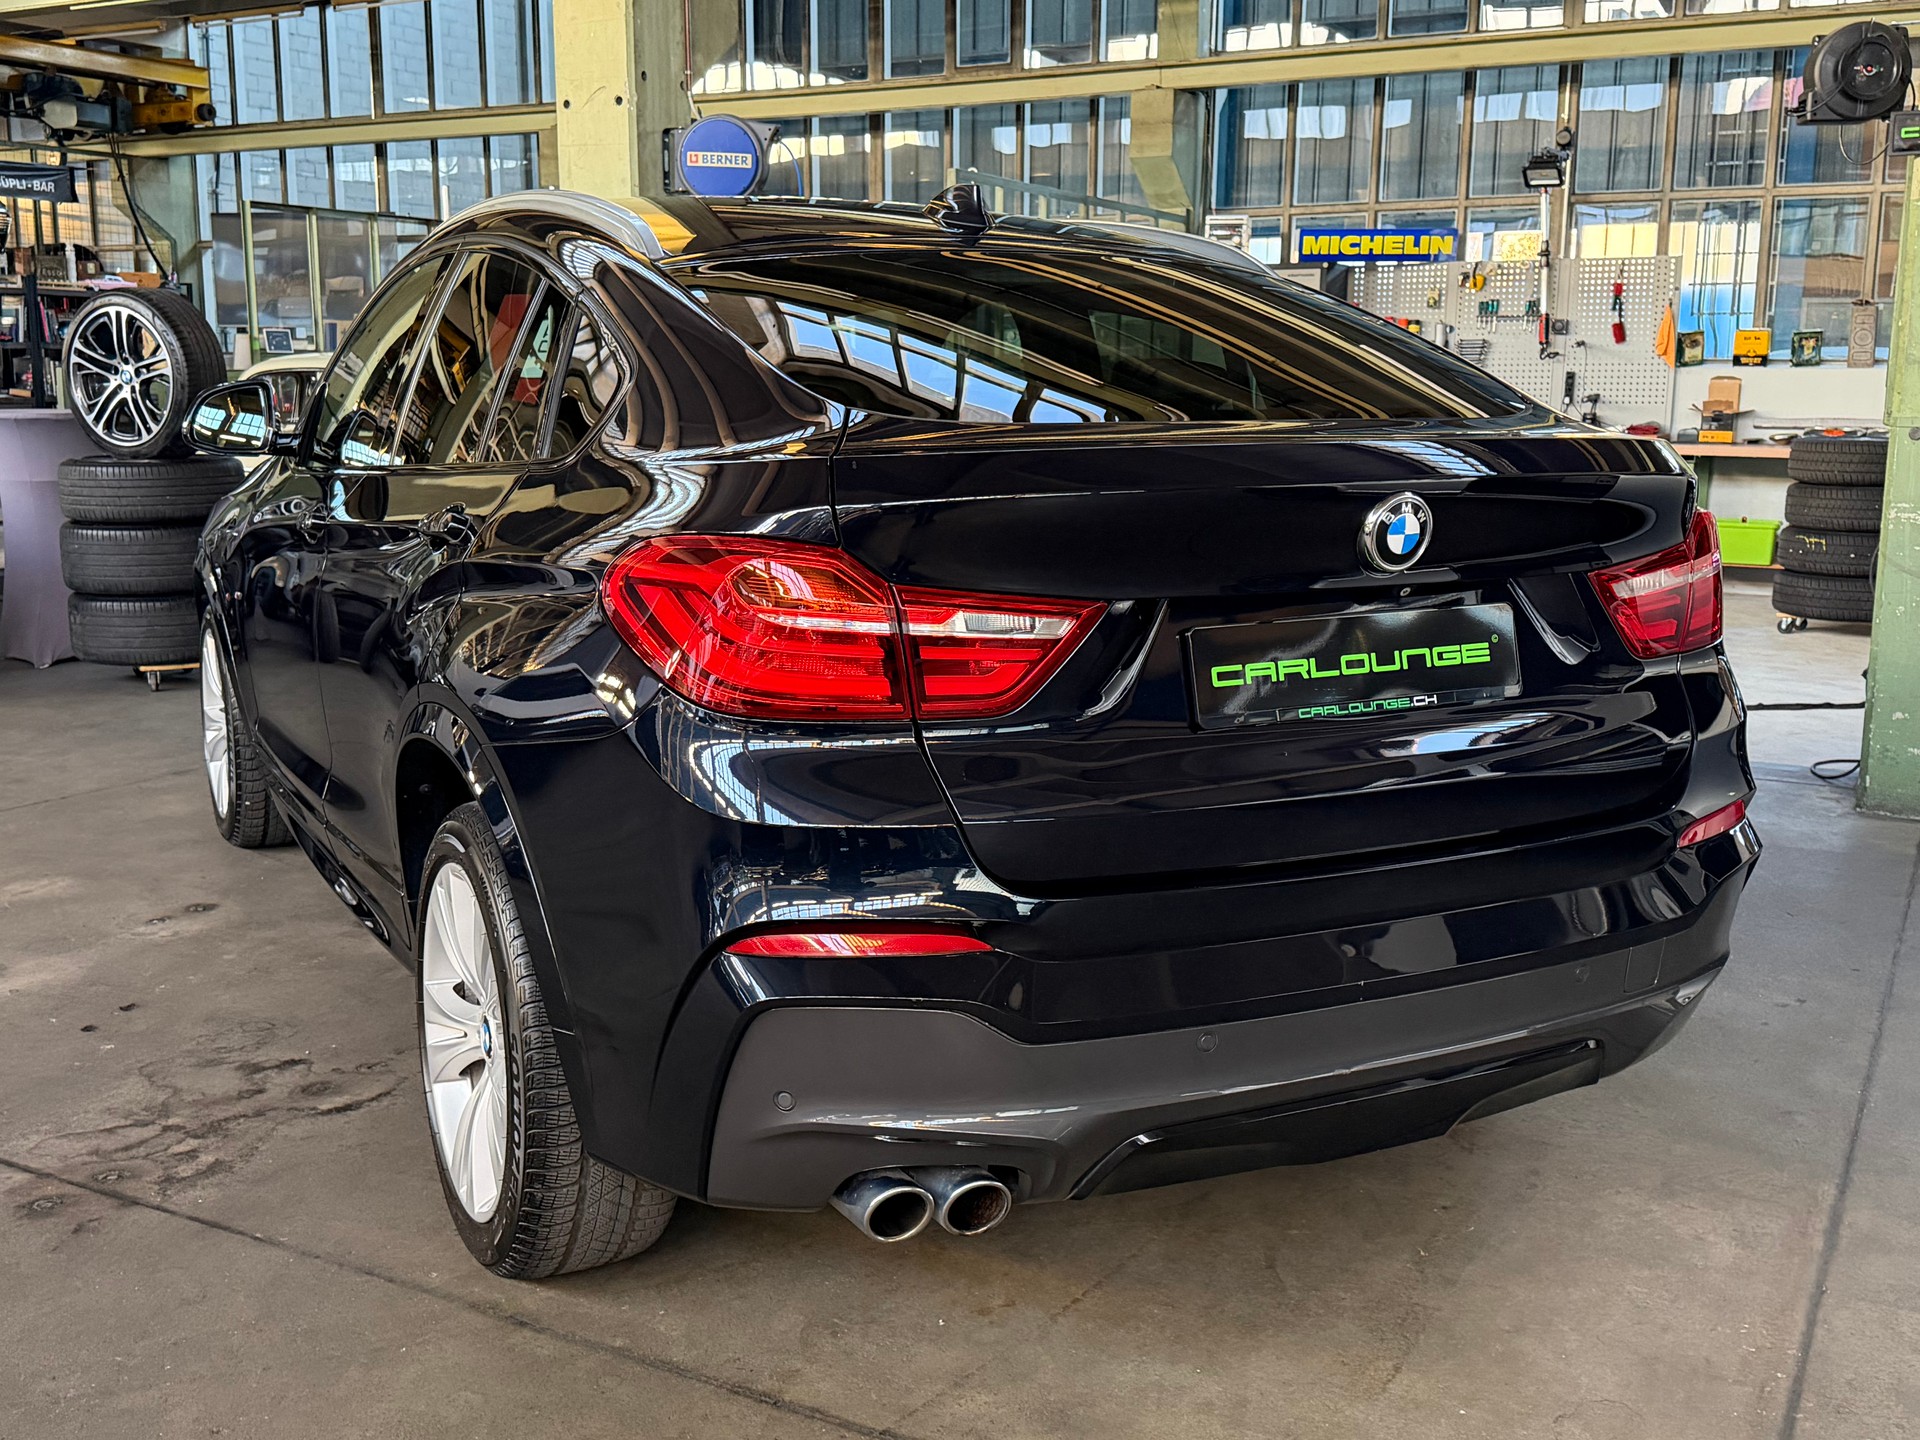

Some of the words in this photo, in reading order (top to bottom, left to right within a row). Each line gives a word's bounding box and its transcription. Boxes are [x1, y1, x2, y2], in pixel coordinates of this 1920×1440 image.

[702, 154, 748, 166] BERNER
[0, 175, 55, 192] ÜPLI-BAR
[1302, 236, 1453, 255] MICHELIN
[1382, 502, 1427, 525] BMW
[1211, 642, 1490, 688] CARLOUNGE
[1298, 694, 1438, 719] CARLOUNGE.CH
